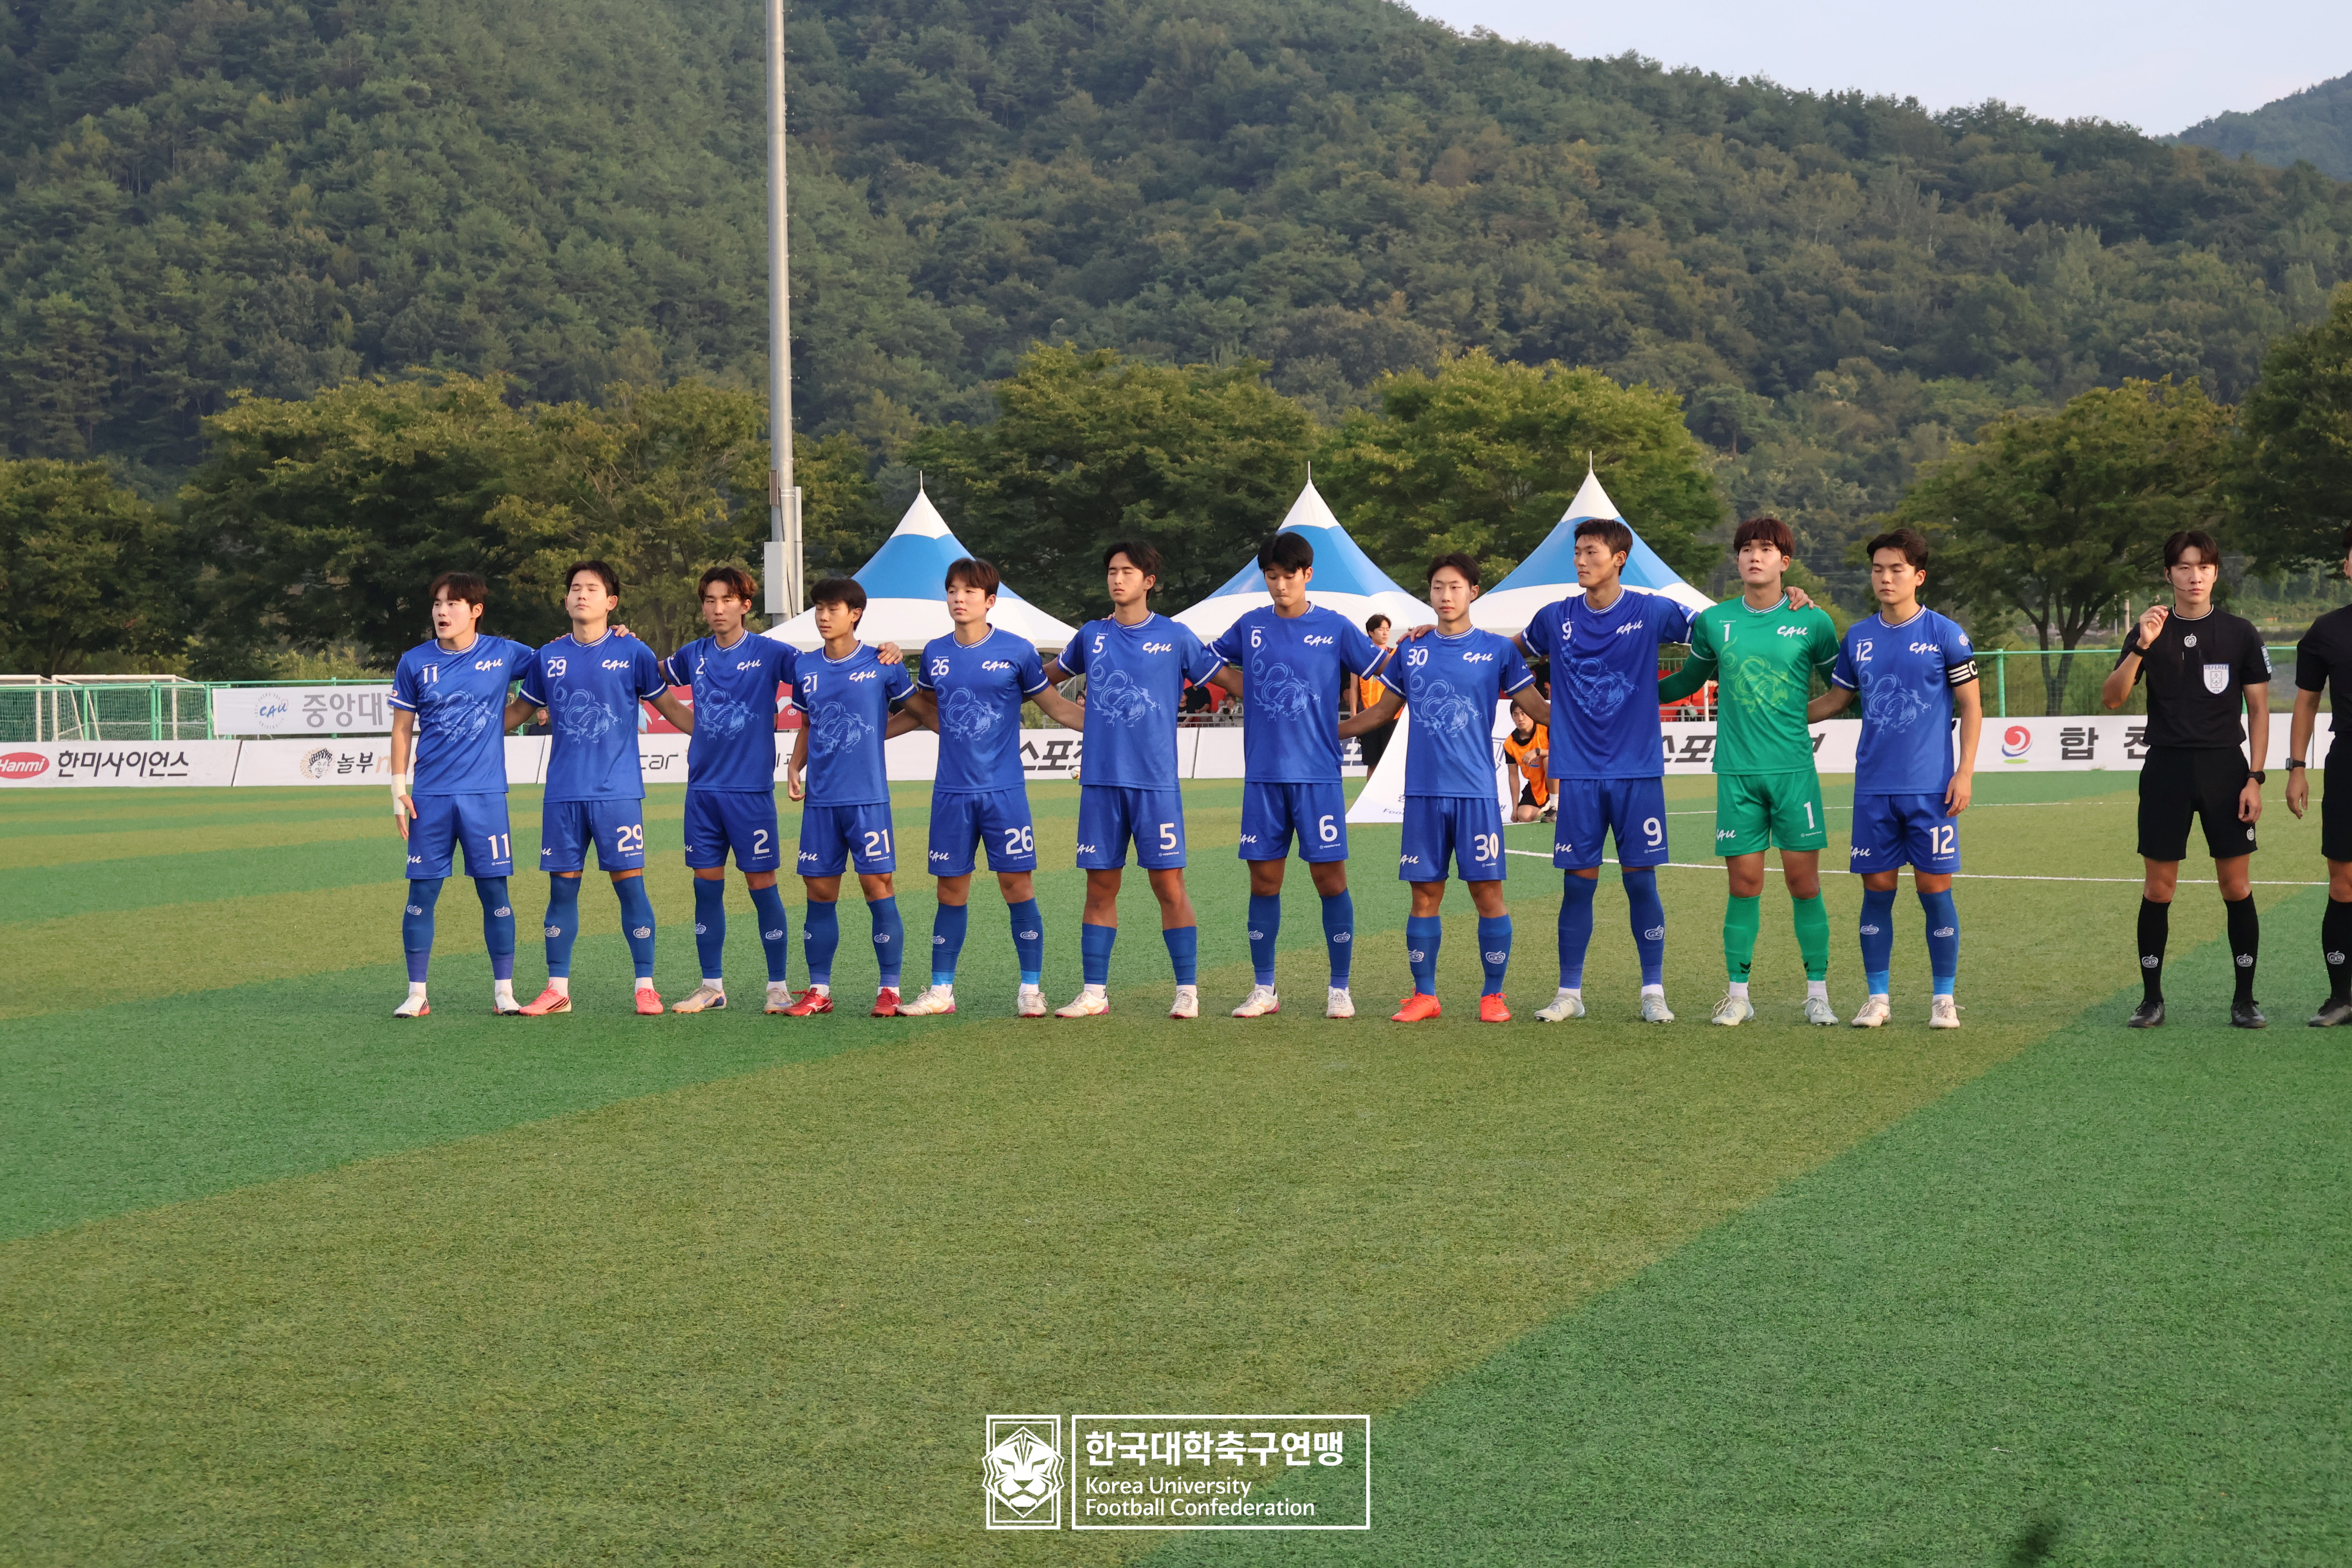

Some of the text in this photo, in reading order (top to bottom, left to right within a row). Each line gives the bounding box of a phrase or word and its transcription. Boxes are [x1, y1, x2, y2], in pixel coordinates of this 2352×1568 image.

[1251, 630, 1261, 648] 6
[1562, 621, 1572, 640] 9
[1724, 624, 1730, 642] 1
[1777, 626, 1808, 638] CAU
[1093, 635, 1105, 653] 5
[1143, 642, 1172, 654] CAU
[1304, 634, 1333, 647] CAU
[1909, 642, 1939, 655] CAU
[1407, 648, 1428, 666] 30
[1463, 652, 1493, 664] CAU
[1857, 641, 1873, 661] 12
[475, 659, 503, 671] CAU
[548, 659, 567, 678] 29
[602, 659, 630, 671] CAU
[696, 657, 705, 675] 2
[931, 659, 949, 676] 26
[982, 660, 1010, 672] CAU
[1969, 661, 1978, 675] C
[423, 666, 437, 684] 11
[803, 673, 818, 693] 21
[849, 670, 877, 682] CAU
[260, 703, 288, 718] CAU
[302, 693, 394, 728] 중앙대
[2060, 727, 2099, 760] 합
[0, 758, 46, 772] Hanmi
[58, 750, 189, 777] 한미사이언스
[337, 751, 373, 774] 놀부
[1804, 801, 1815, 829] 1
[1160, 823, 1176, 850] 5
[1319, 815, 1338, 842] 6
[1643, 817, 1662, 846] 9
[488, 833, 510, 860] 11
[617, 824, 644, 852] 29
[753, 829, 769, 854] 2
[864, 829, 890, 857] 21
[1005, 826, 1034, 855] 26
[1474, 832, 1499, 861] 30
[1929, 825, 1955, 854] 12
